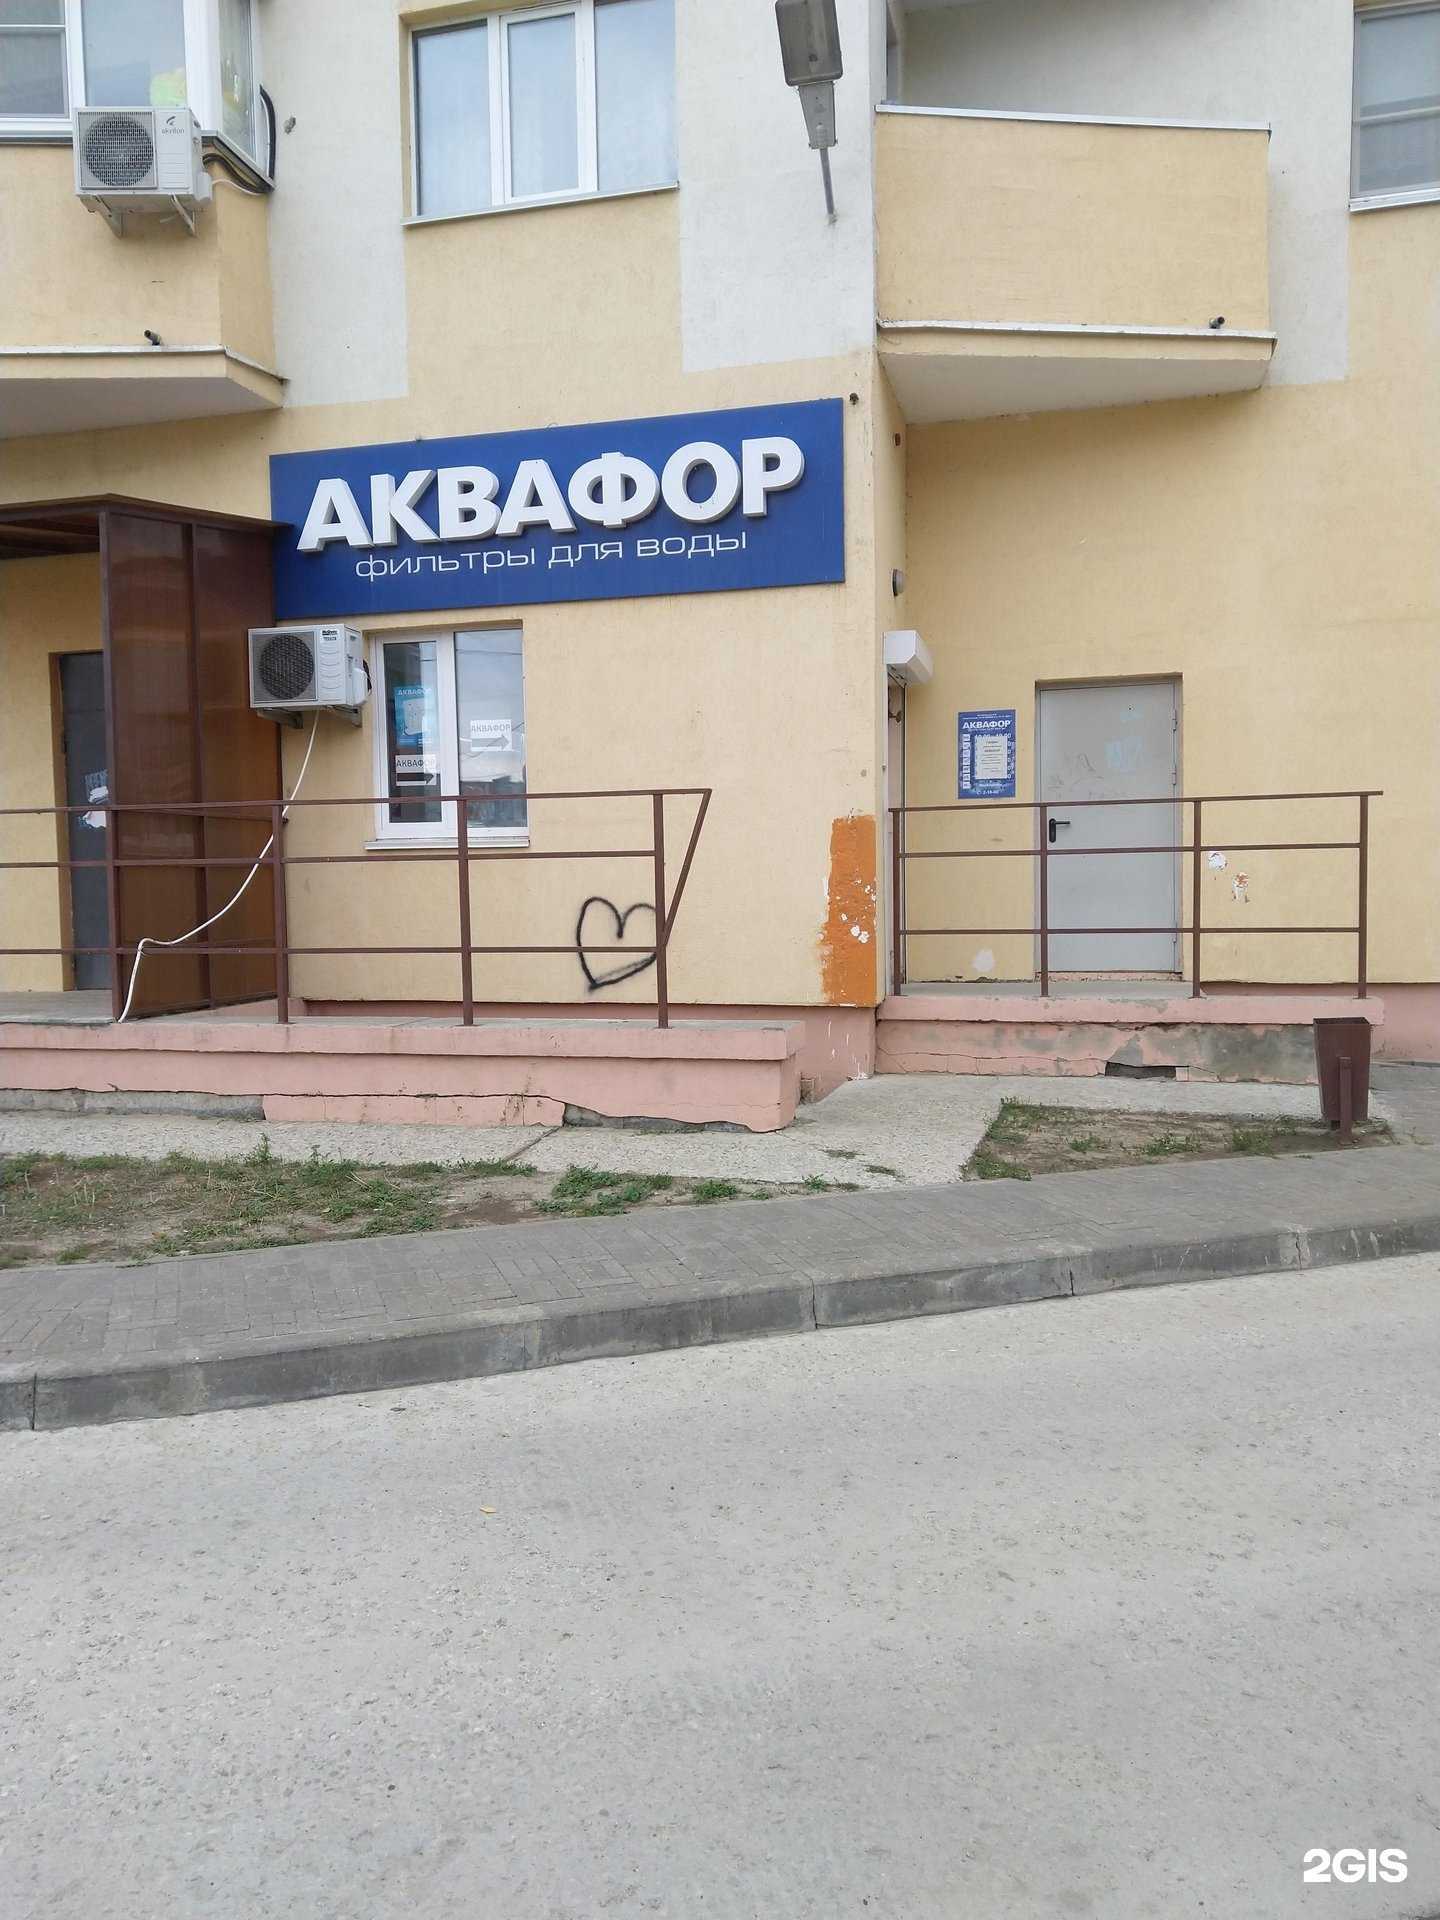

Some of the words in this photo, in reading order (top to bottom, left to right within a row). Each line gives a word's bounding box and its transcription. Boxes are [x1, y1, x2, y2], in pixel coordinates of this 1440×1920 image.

[297, 436, 806, 552] АКВАФОР
[355, 547, 535, 583] фильтры
[548, 540, 623, 567] для
[637, 531, 747, 557] воды
[471, 724, 511, 733] АКВАФОР
[962, 719, 1012, 730] АКВАФОР
